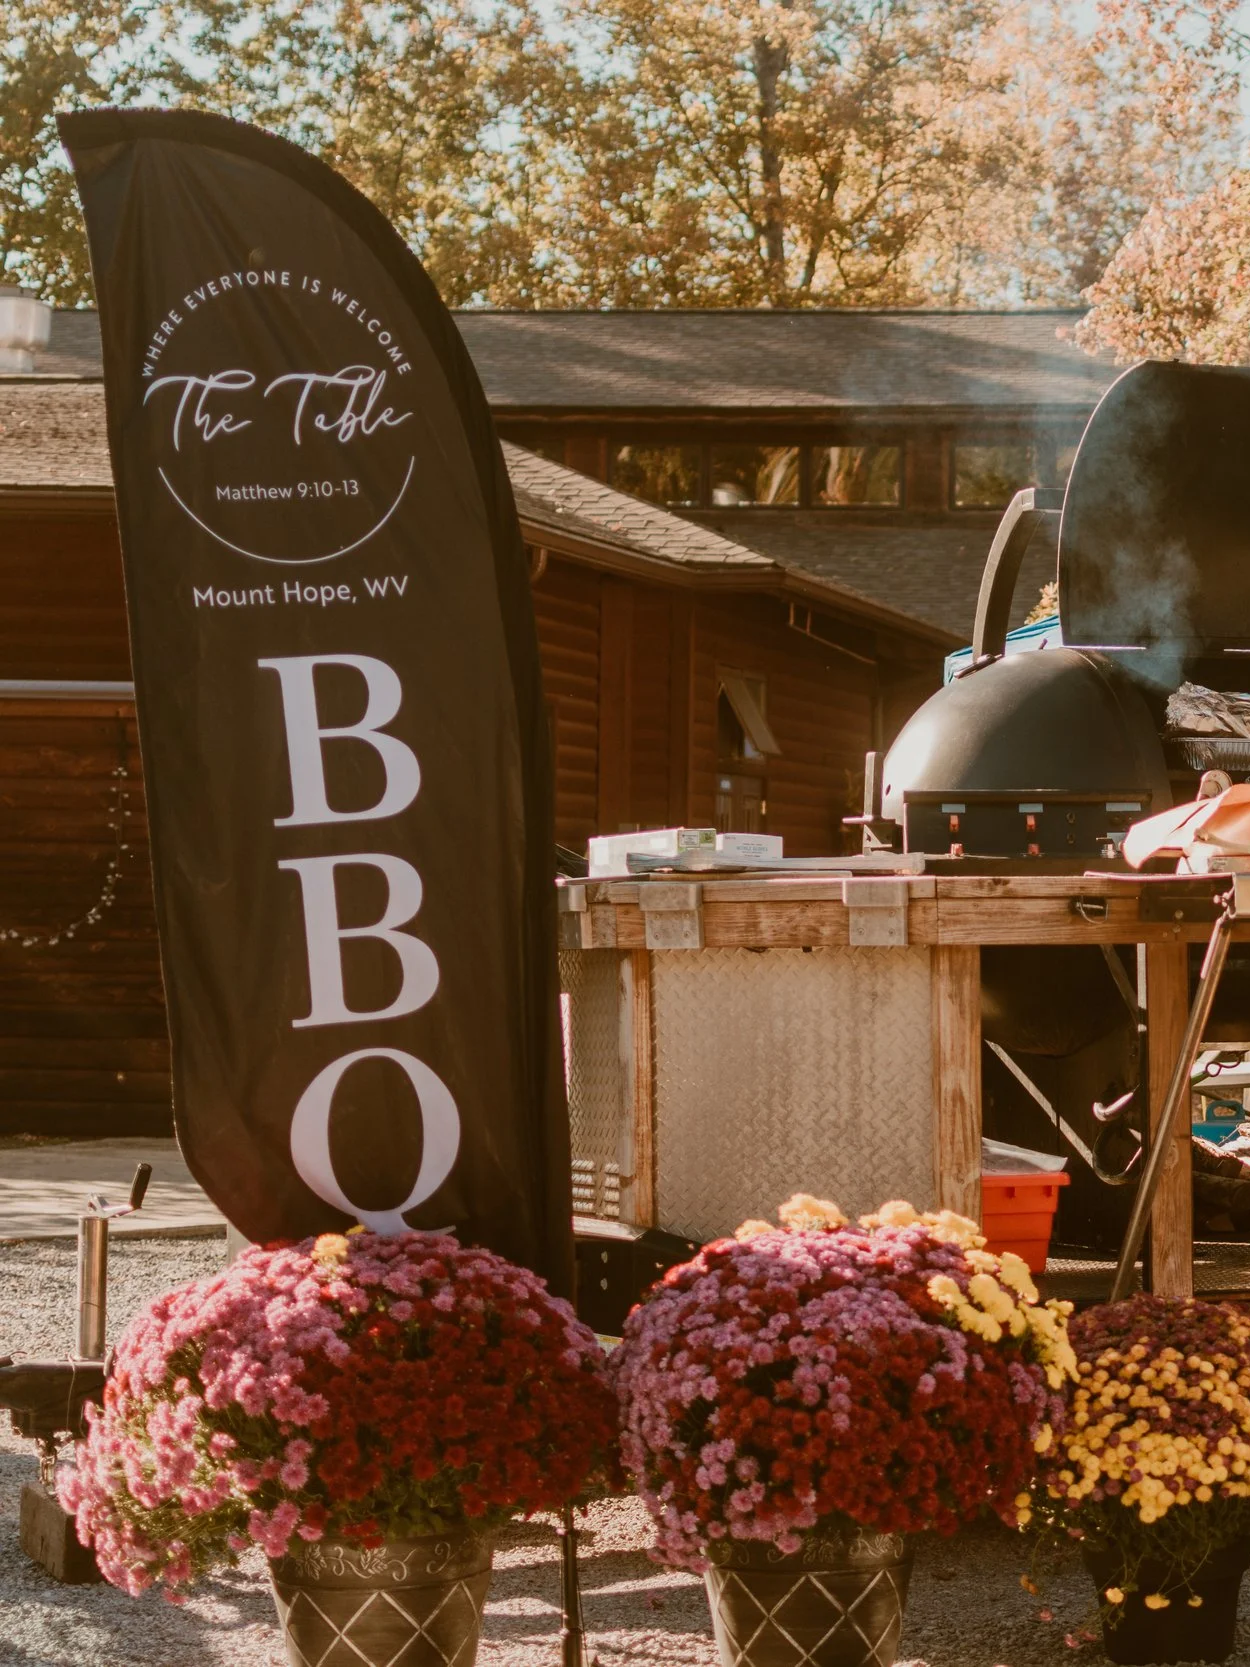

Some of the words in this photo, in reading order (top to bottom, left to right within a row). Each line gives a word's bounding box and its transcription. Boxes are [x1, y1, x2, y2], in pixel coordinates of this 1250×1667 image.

[141, 309, 185, 378] WHERE
[184, 271, 291, 312] EVERYONE
[302, 275, 321, 294] IS
[332, 288, 412, 376] WELCOME
[142, 369, 256, 452] The
[263, 365, 414, 446] Table
[216, 483, 292, 501] Matthew
[297, 479, 360, 500] 9:10-13
[193, 583, 275, 609] Mount
[283, 580, 358, 607] Hope,
[364, 575, 409, 598] WV
[257, 653, 460, 1237] BBQ
